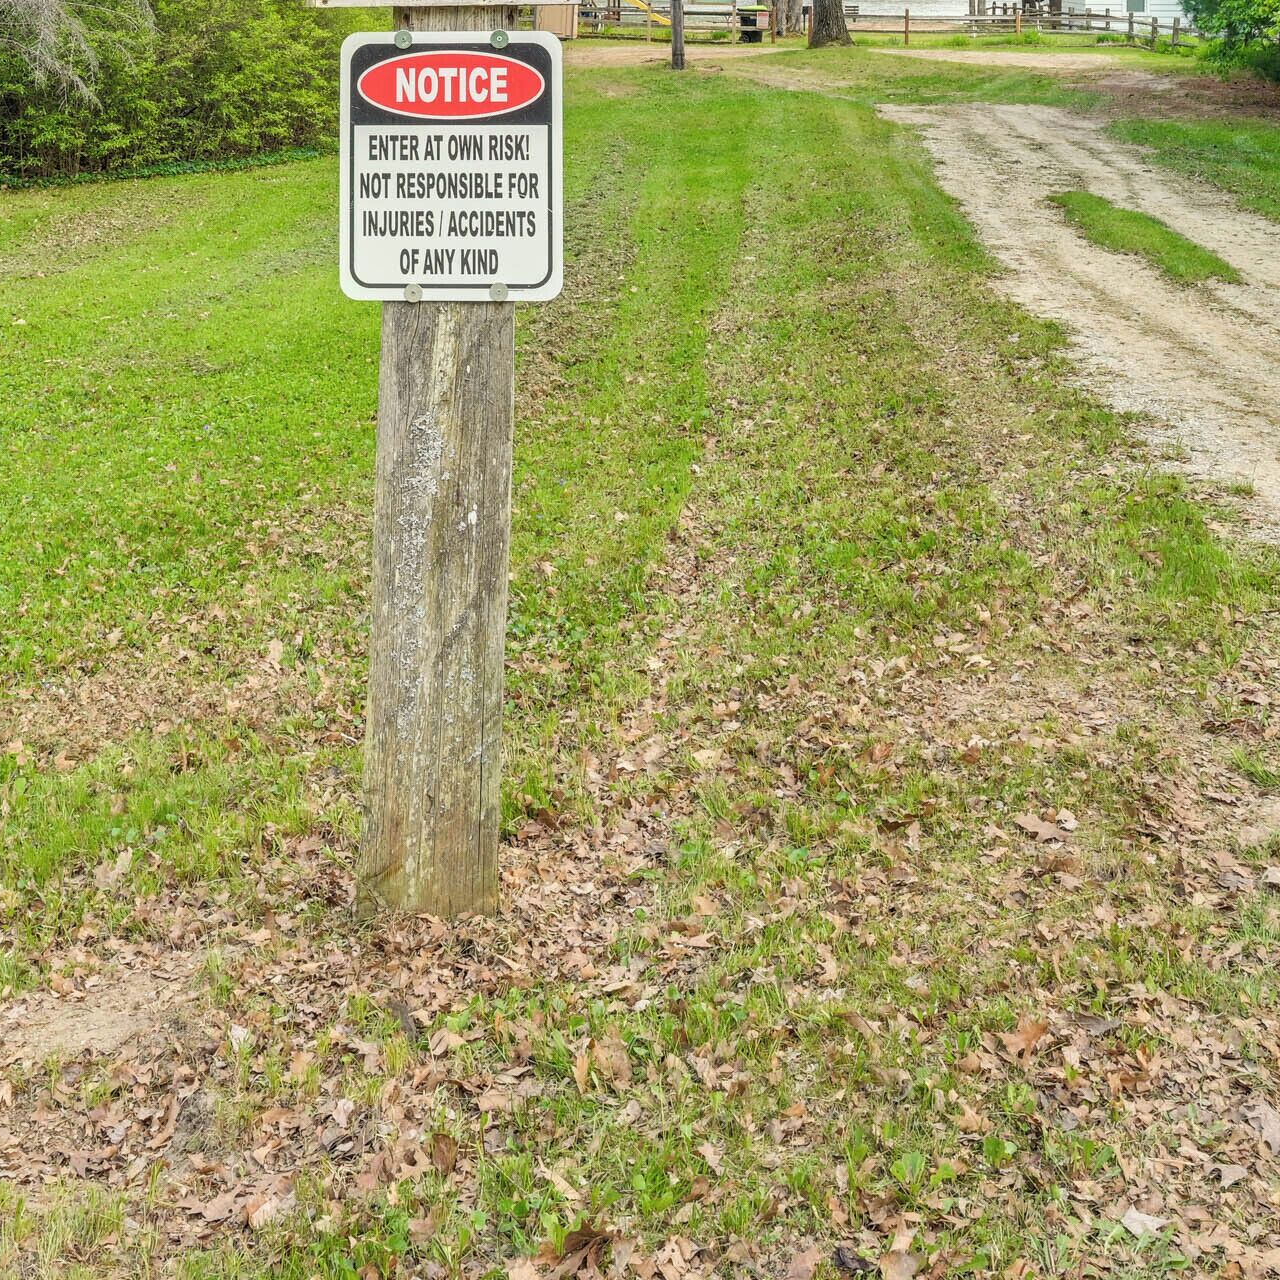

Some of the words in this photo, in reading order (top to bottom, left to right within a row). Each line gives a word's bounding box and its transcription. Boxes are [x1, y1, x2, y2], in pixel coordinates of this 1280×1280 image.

[396, 67, 508, 102] NOTICE
[369, 135, 419, 160] ENTER
[424, 135, 443, 160] AT
[448, 135, 482, 160] OWN
[489, 135, 529, 160] RISK!
[360, 173, 391, 198] NOT
[397, 173, 502, 198] RESPONSIBLE
[509, 173, 539, 198] FOR
[363, 211, 434, 236] INJURIES
[439, 211, 443, 236] /
[448, 211, 535, 237] ACCIDENTS
[400, 249, 419, 274] OF
[423, 249, 455, 274] ANY
[461, 249, 498, 274] KIND
